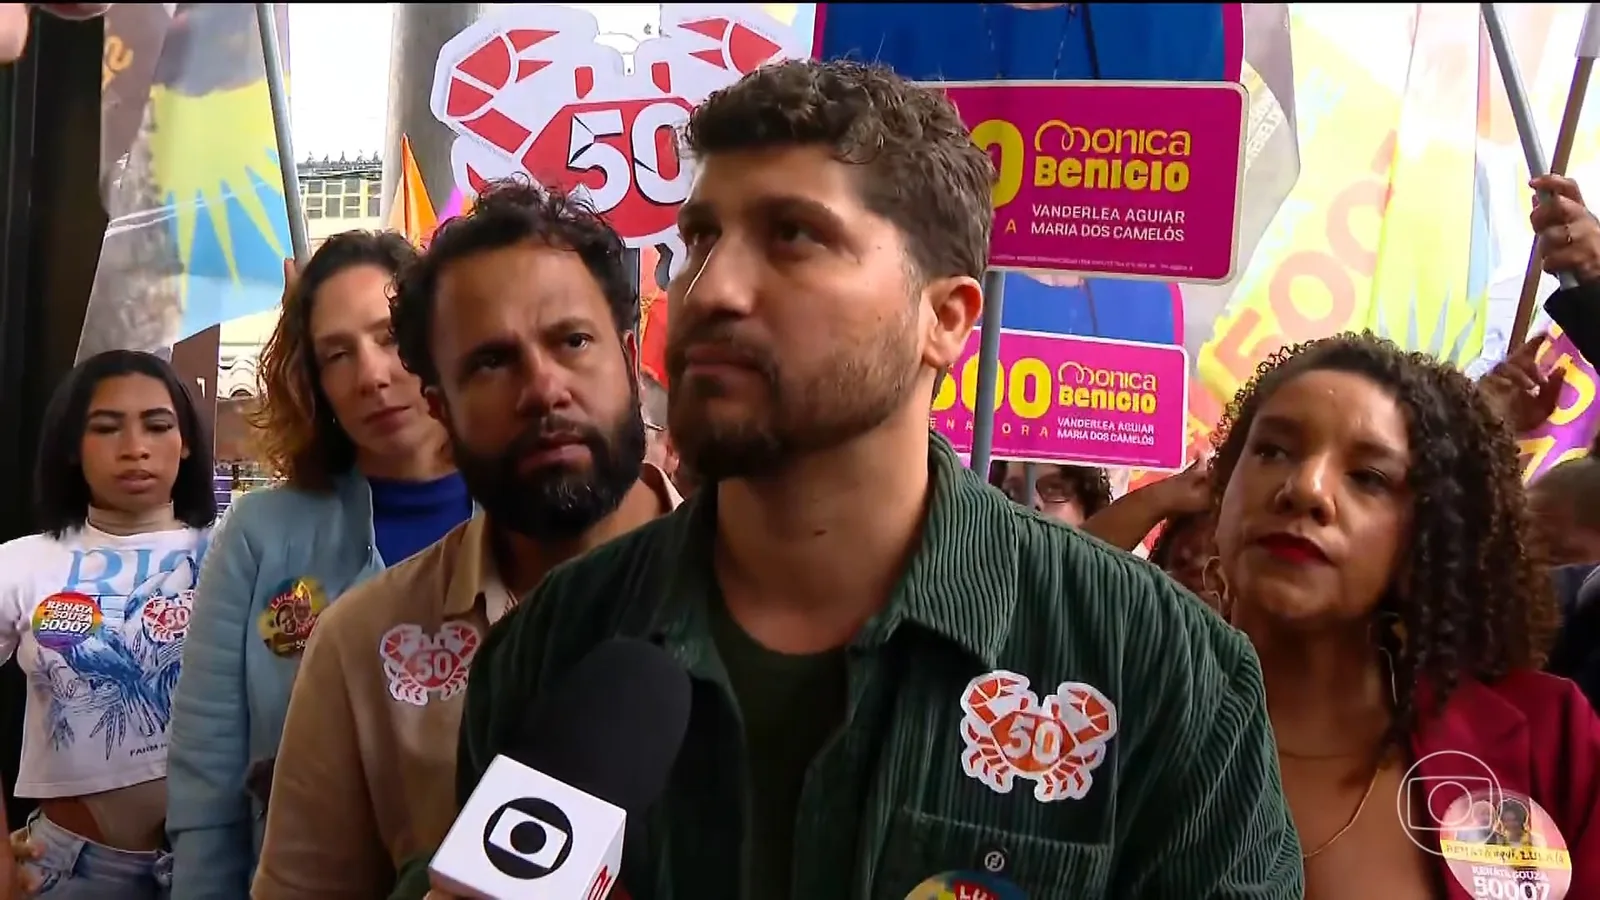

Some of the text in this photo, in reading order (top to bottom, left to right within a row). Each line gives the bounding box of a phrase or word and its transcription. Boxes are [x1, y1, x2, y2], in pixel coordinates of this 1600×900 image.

[567, 102, 697, 213] 50
[1031, 203, 1186, 224] VANDERLEA AGUIAR
[1031, 221, 1079, 237] MARIA
[1080, 224, 1111, 239] DOS
[1057, 416, 1155, 435] VANDERLEA AGUIAR
[1057, 429, 1089, 440] MARIA
[1090, 430, 1110, 442] DOS
[45, 600, 94, 615] RENATA
[40, 619, 91, 634] 50007
[413, 651, 452, 683] 50
[1002, 714, 1064, 765] 50
[1473, 875, 1551, 900] 50007
